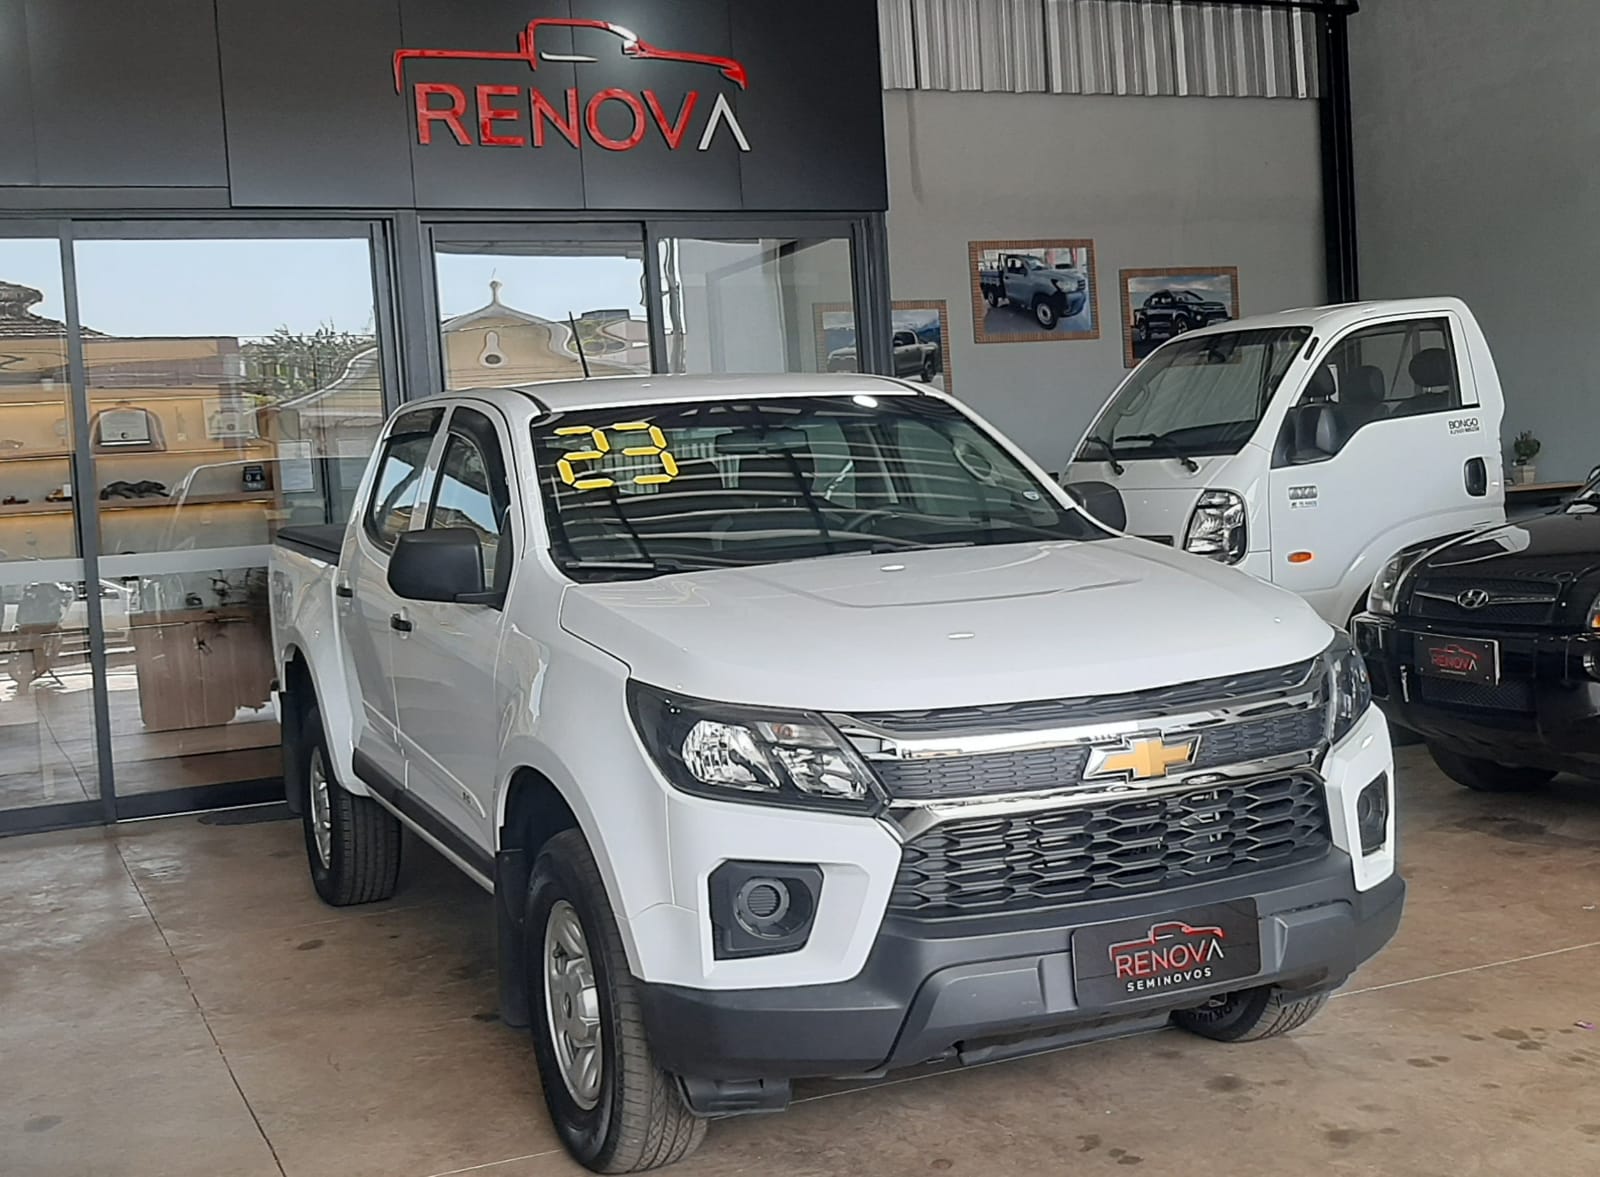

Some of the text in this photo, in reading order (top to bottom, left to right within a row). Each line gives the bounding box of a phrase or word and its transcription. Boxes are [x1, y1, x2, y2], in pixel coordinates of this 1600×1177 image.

[413, 82, 751, 151] RENOVA
[1115, 938, 1225, 979] RENOVA
[1127, 966, 1213, 992] SEMINOVOS
